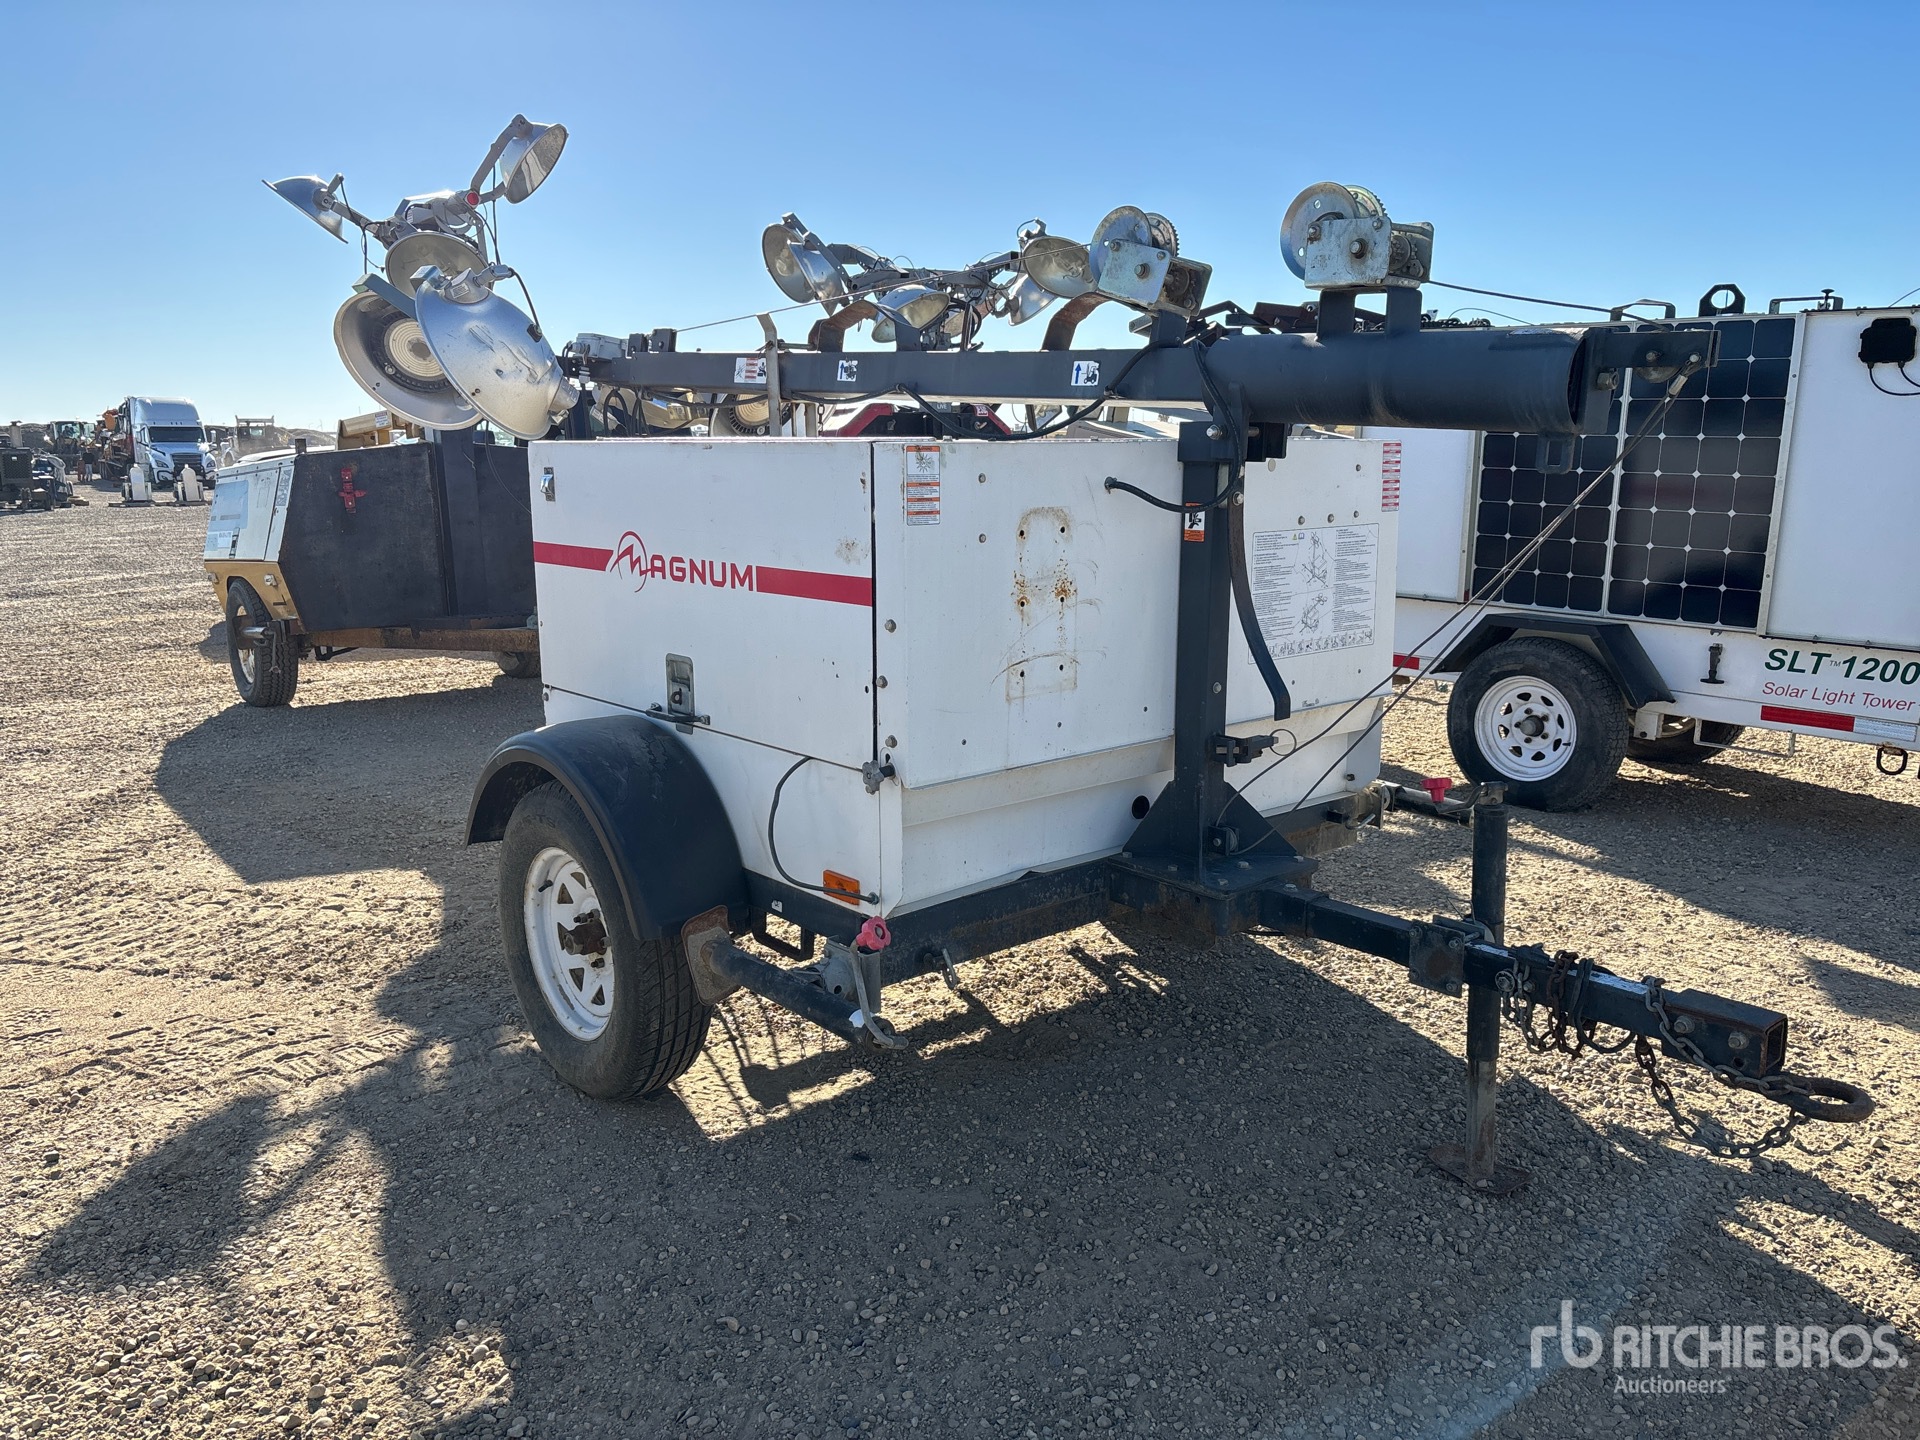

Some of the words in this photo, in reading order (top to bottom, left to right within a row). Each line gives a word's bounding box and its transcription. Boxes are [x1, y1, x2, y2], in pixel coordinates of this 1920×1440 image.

[610, 531, 753, 593] MAGNUM
[1764, 648, 1832, 675] SLT
[1842, 655, 1920, 685] 1200
[1762, 681, 1808, 699] Solar
[1811, 686, 1856, 706] Light
[1862, 692, 1917, 711] Tower
